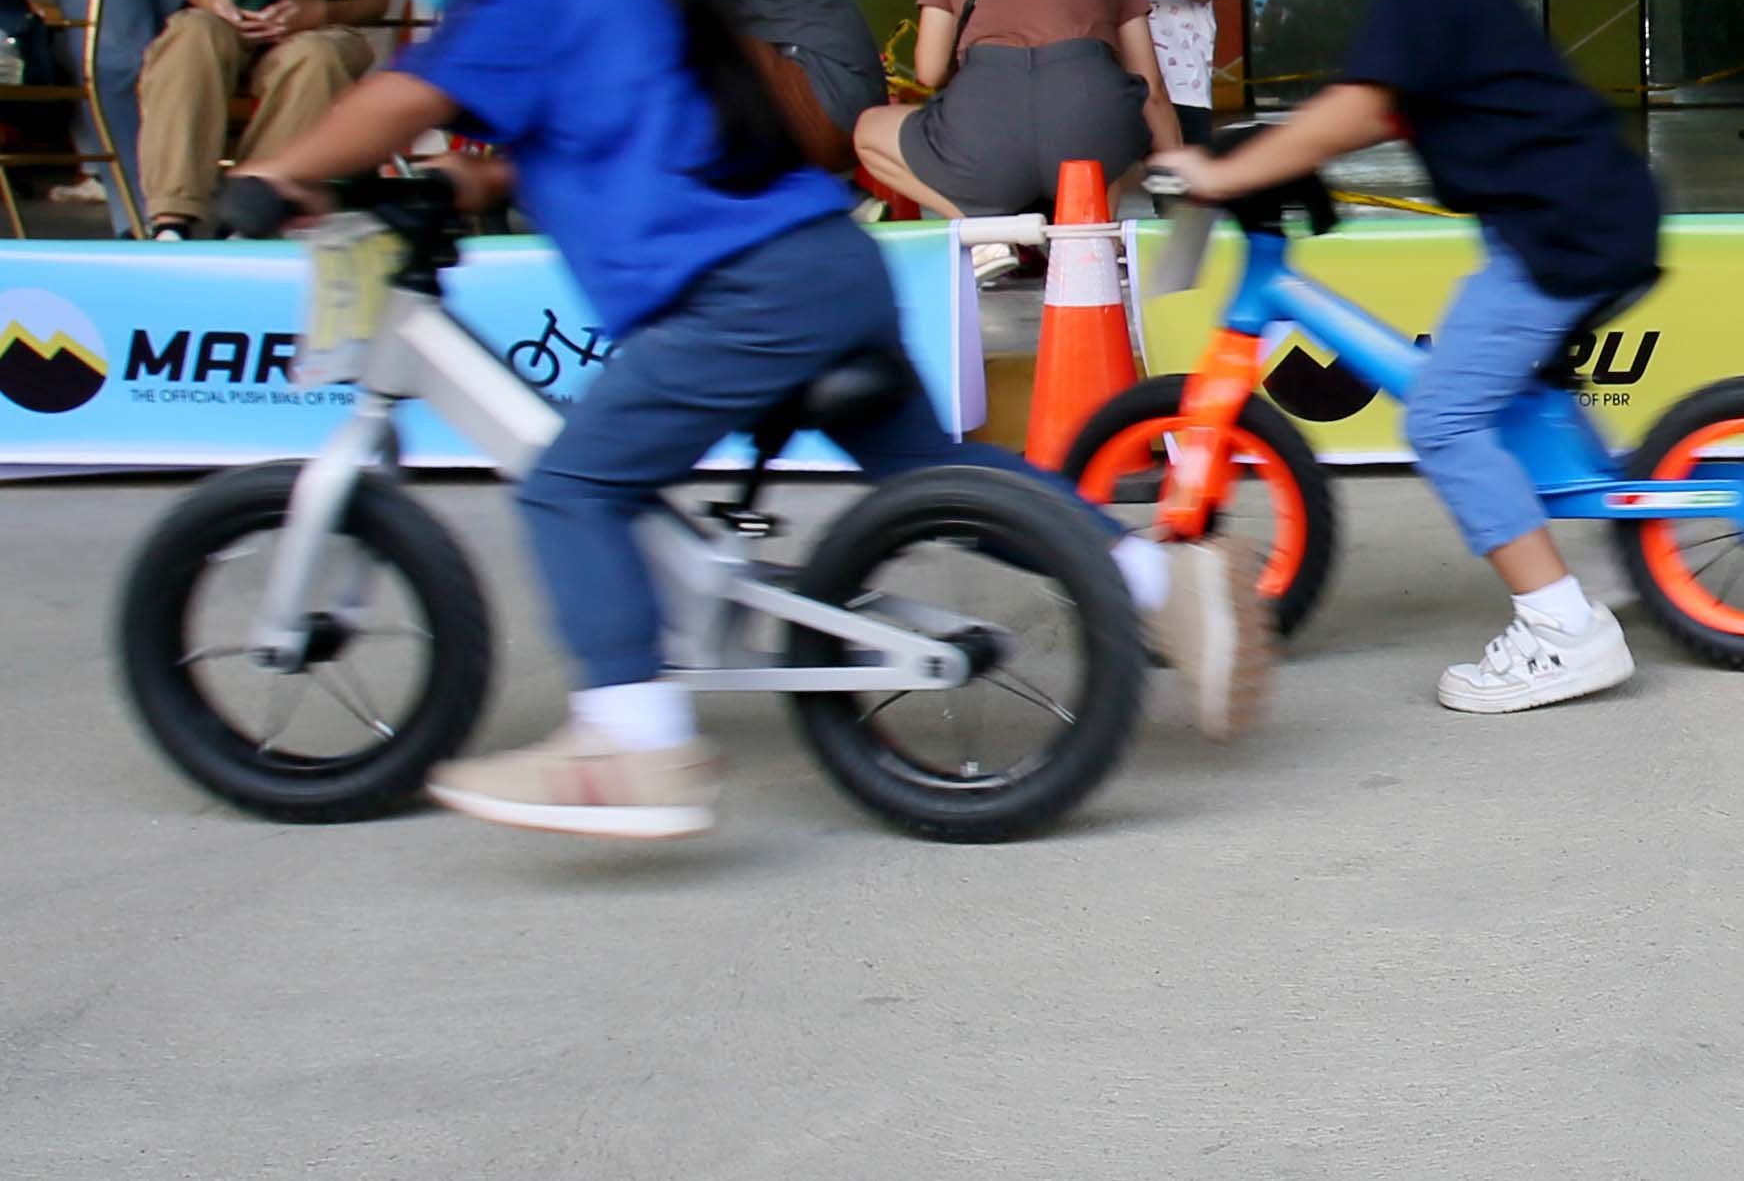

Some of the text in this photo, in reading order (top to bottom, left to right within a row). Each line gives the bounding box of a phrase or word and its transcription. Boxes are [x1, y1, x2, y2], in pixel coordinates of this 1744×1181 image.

[122, 329, 302, 384] MAR
[131, 388, 155, 403] THE
[159, 389, 226, 404] OFFICIAL
[230, 390, 267, 404] PUSH
[271, 391, 301, 405] BIKE
[304, 392, 325, 405] OF
[1579, 392, 1631, 407] OF PBR
